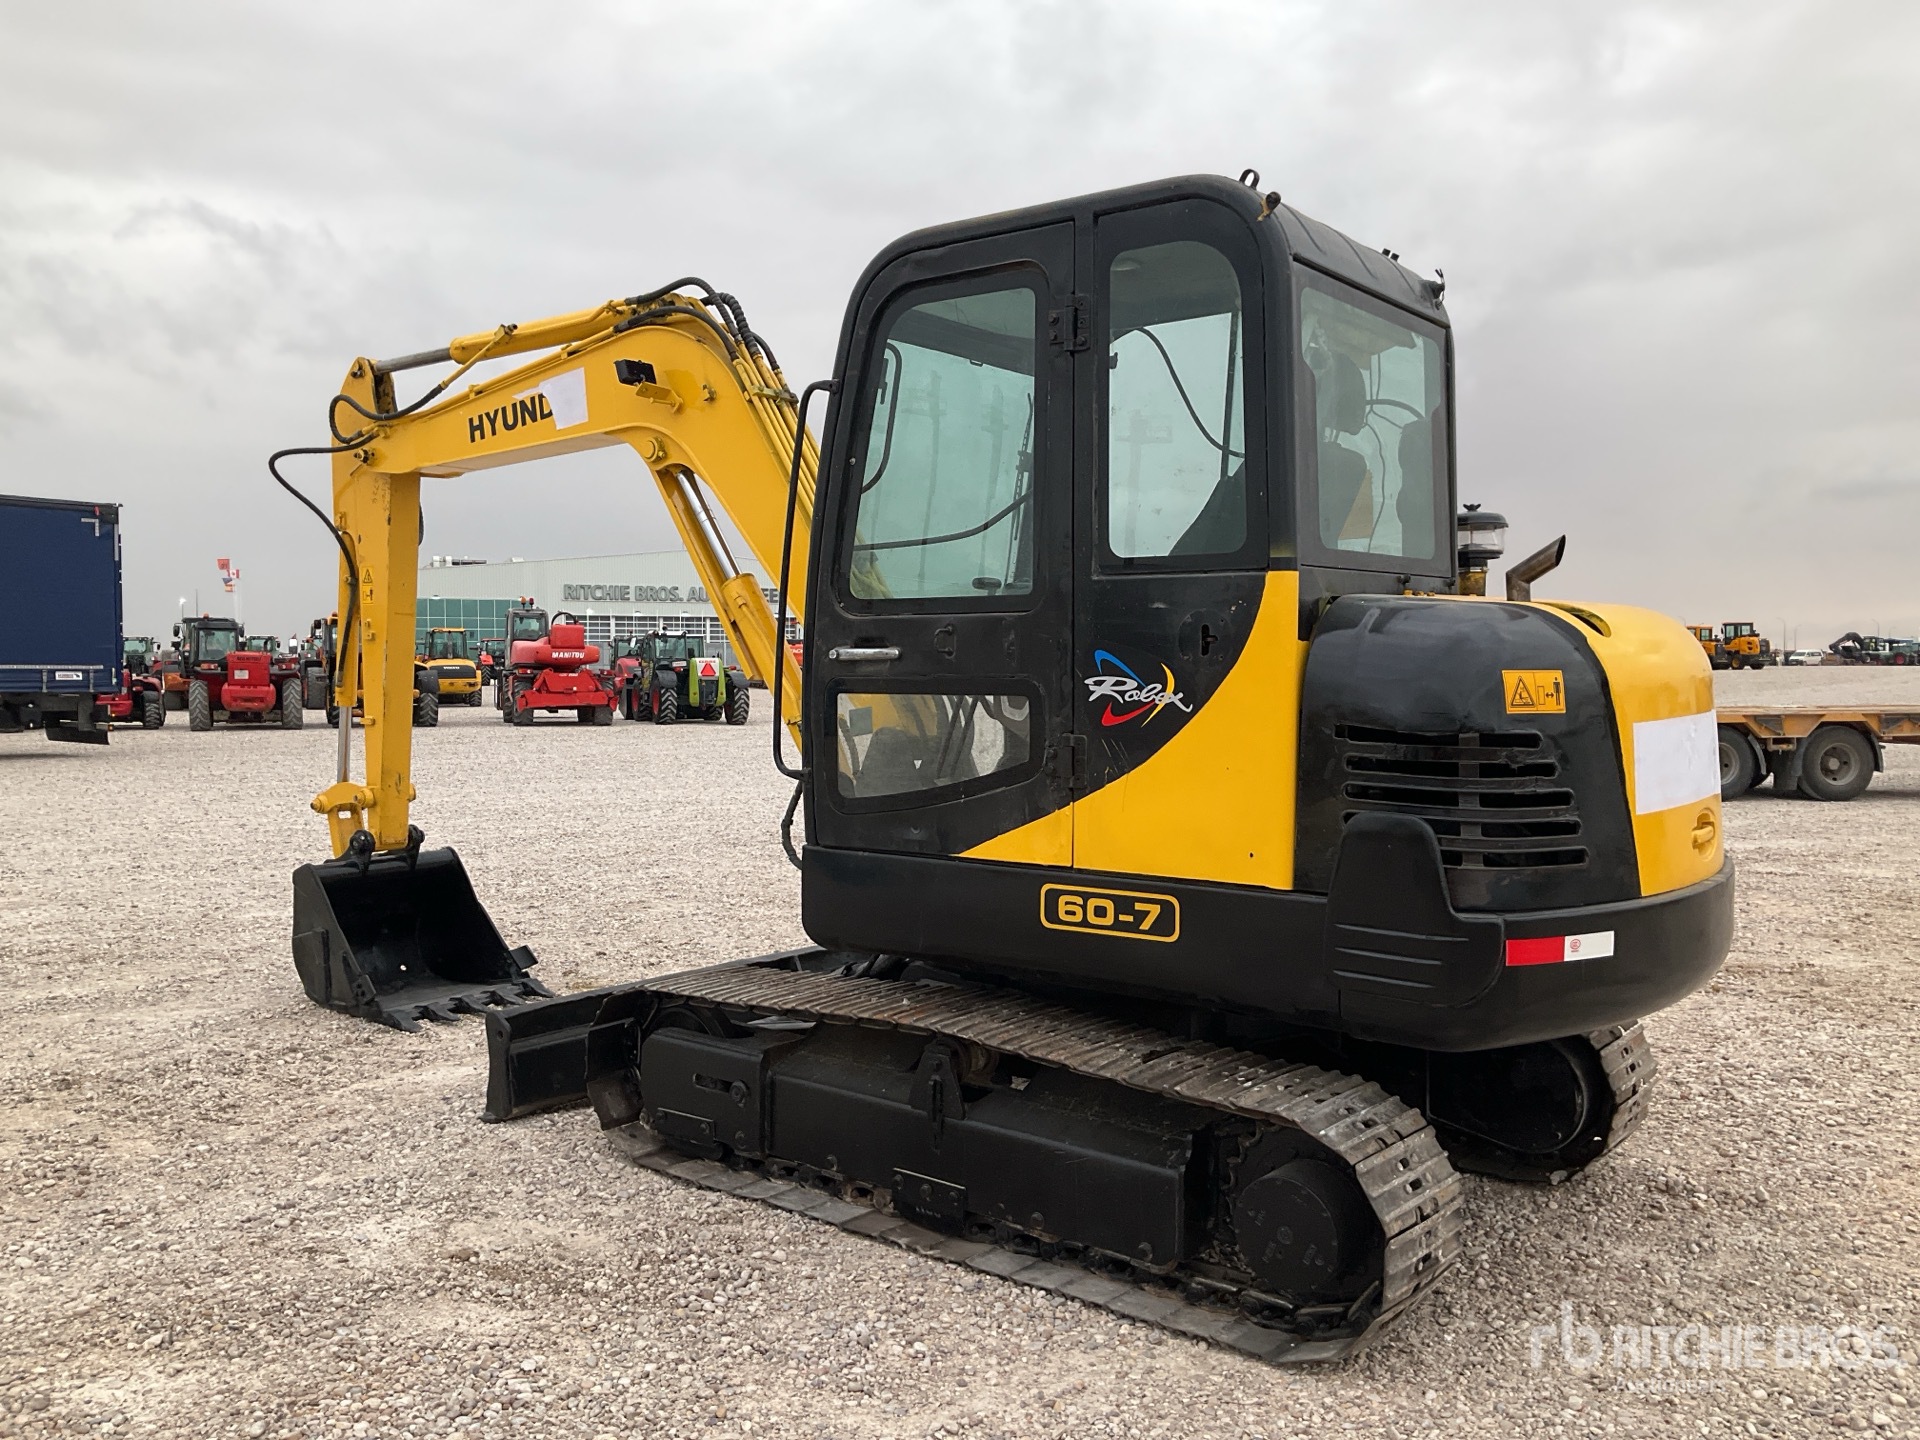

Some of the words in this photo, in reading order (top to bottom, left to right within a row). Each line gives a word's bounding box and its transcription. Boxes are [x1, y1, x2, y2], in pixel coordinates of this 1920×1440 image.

[563, 584, 630, 601] RITCHIE
[634, 585, 684, 602] BROS.
[1083, 675, 1193, 713] Robex
[1057, 894, 1161, 931] 60-7
